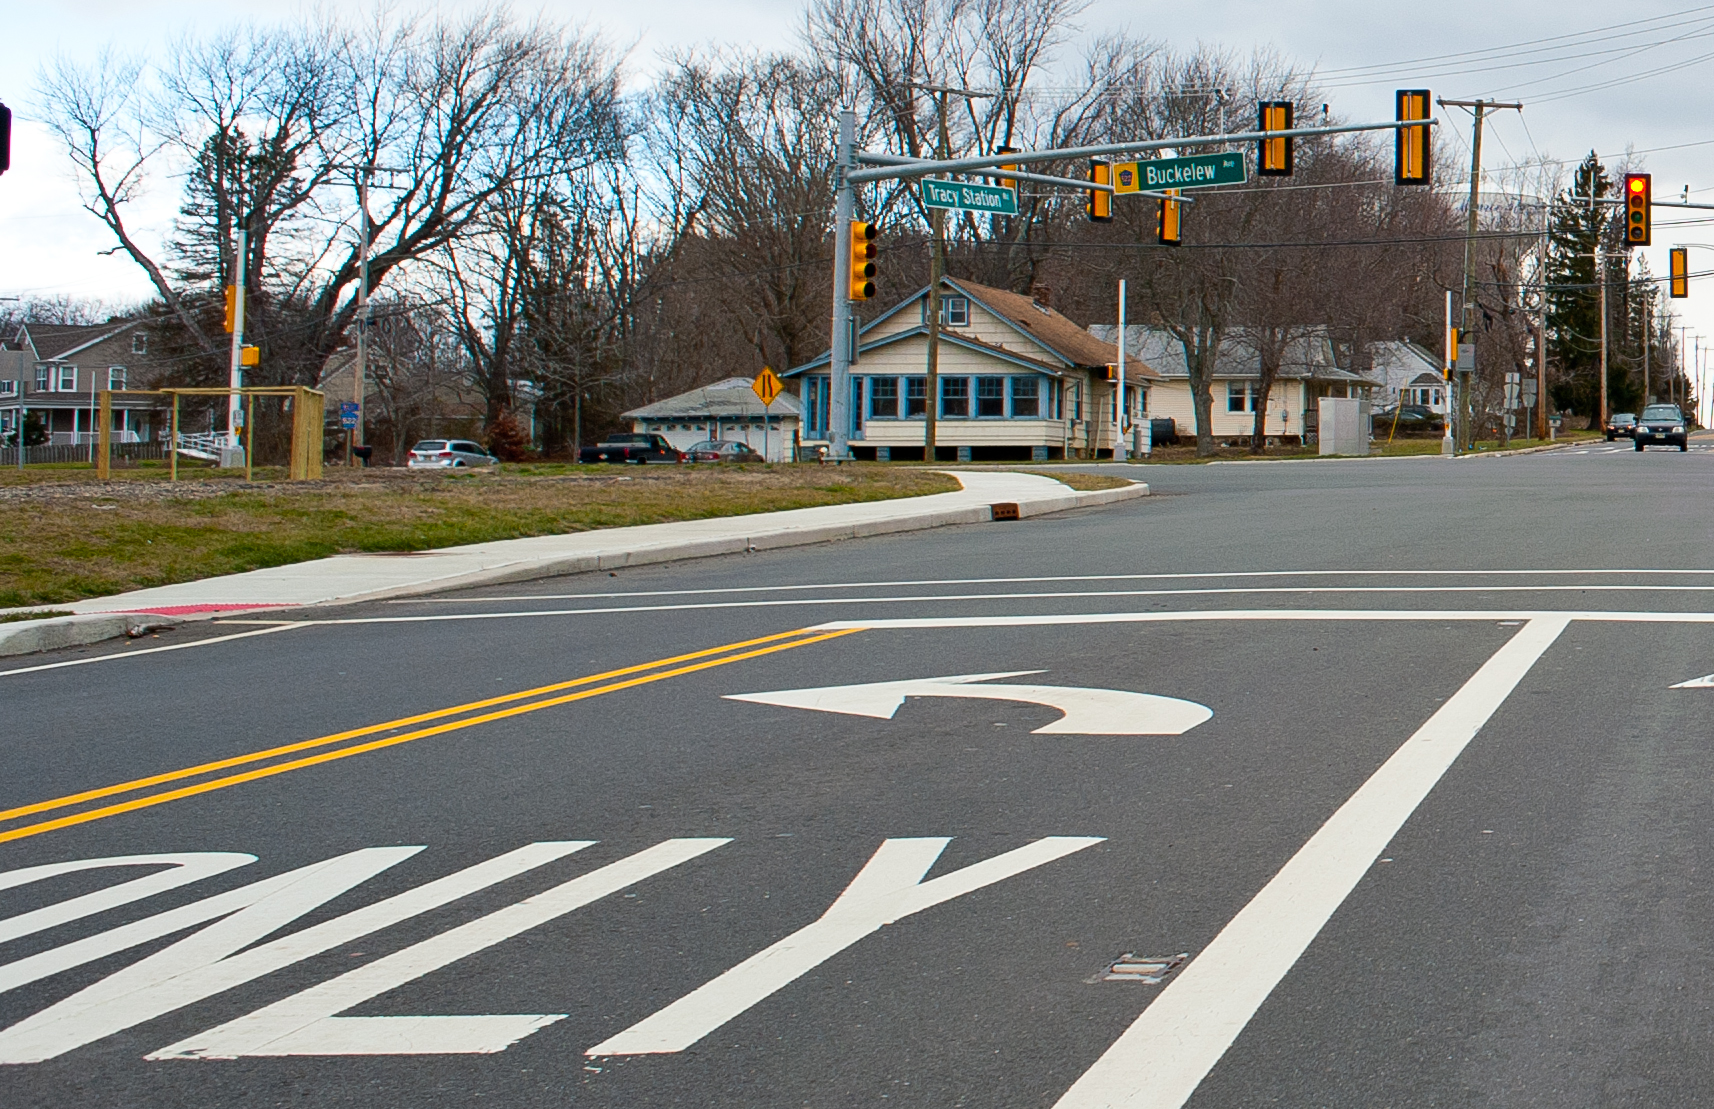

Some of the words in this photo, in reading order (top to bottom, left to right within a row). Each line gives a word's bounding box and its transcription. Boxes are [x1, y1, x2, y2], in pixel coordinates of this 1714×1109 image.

[1146, 163, 1216, 185] Buckelew
[928, 184, 960, 207] Tracy
[962, 187, 1002, 208] Station
